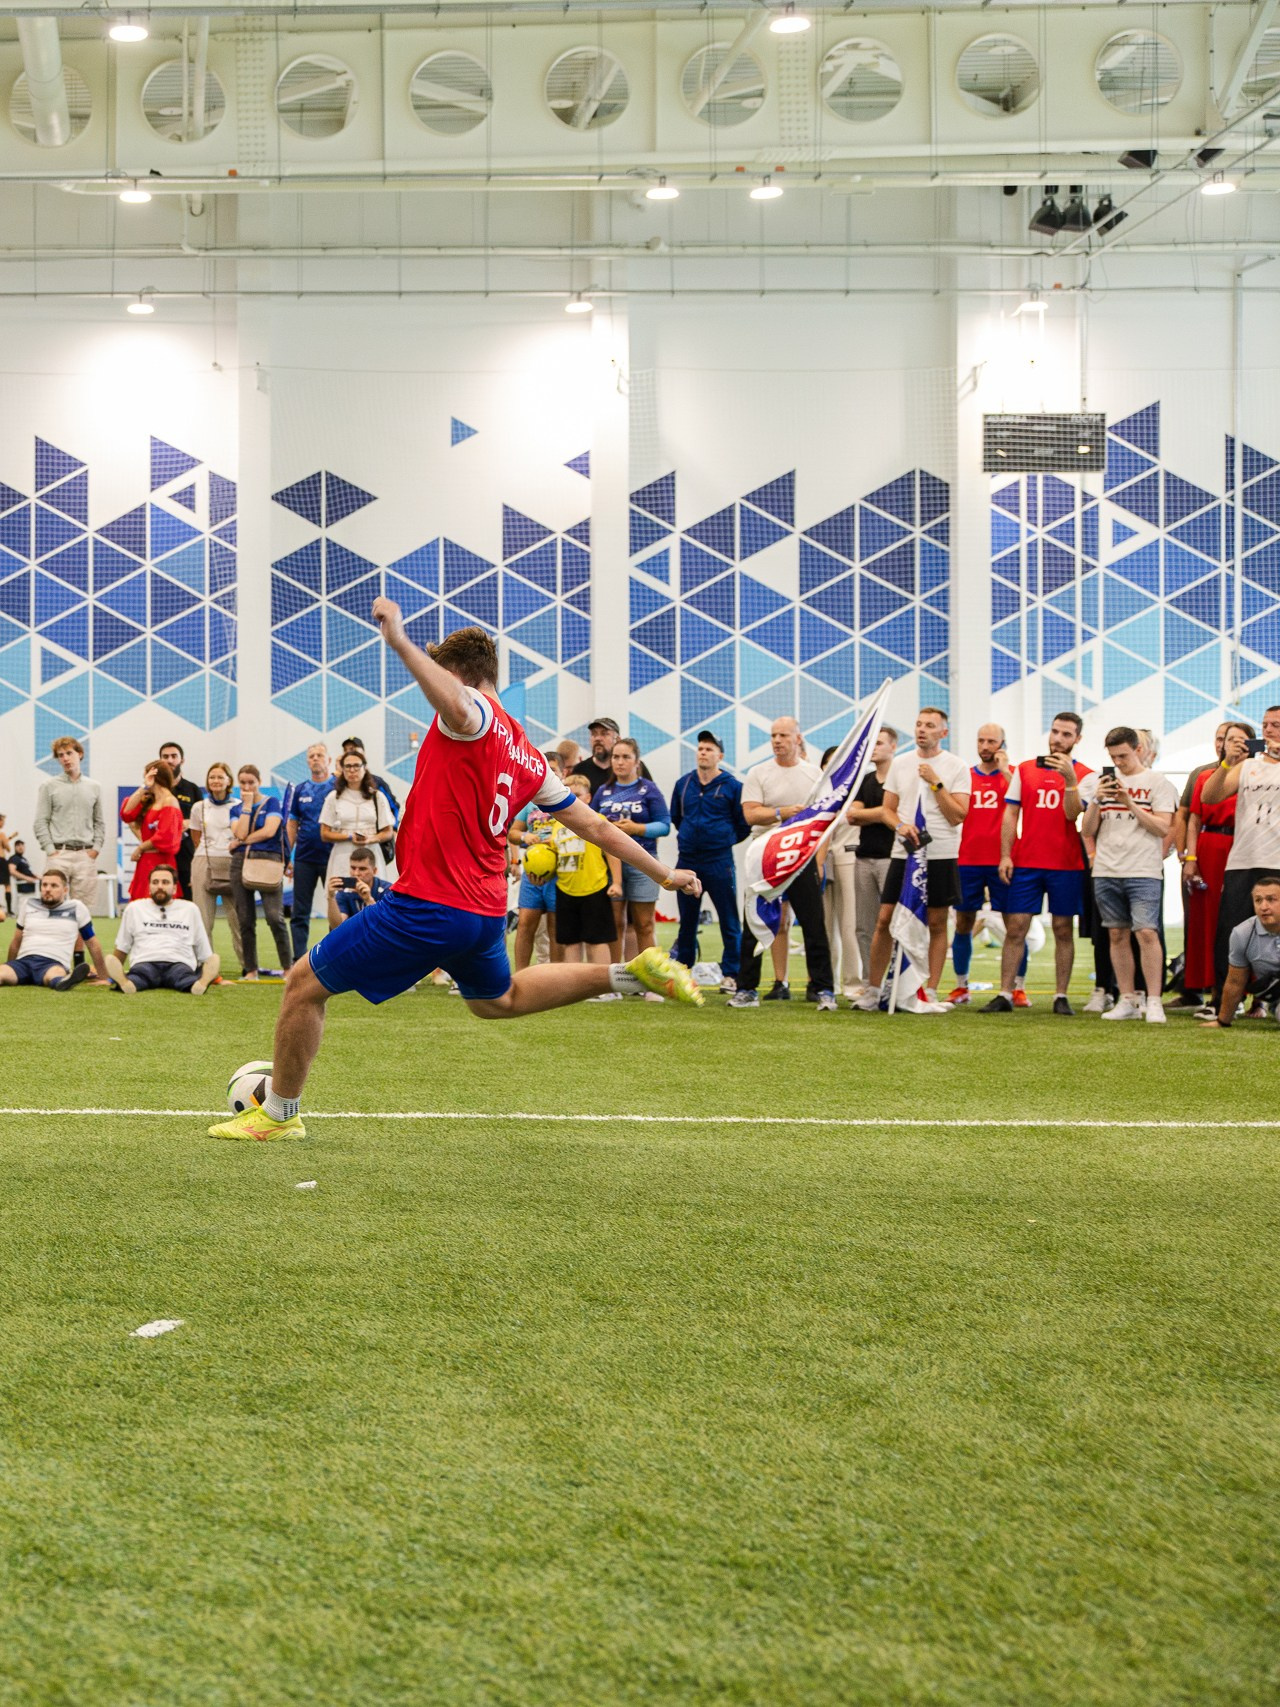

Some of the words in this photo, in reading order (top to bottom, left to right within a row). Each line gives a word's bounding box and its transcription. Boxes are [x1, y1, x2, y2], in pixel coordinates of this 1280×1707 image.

[488, 772, 513, 837] 6
[973, 790, 998, 809] 12
[1035, 788, 1060, 810] 10
